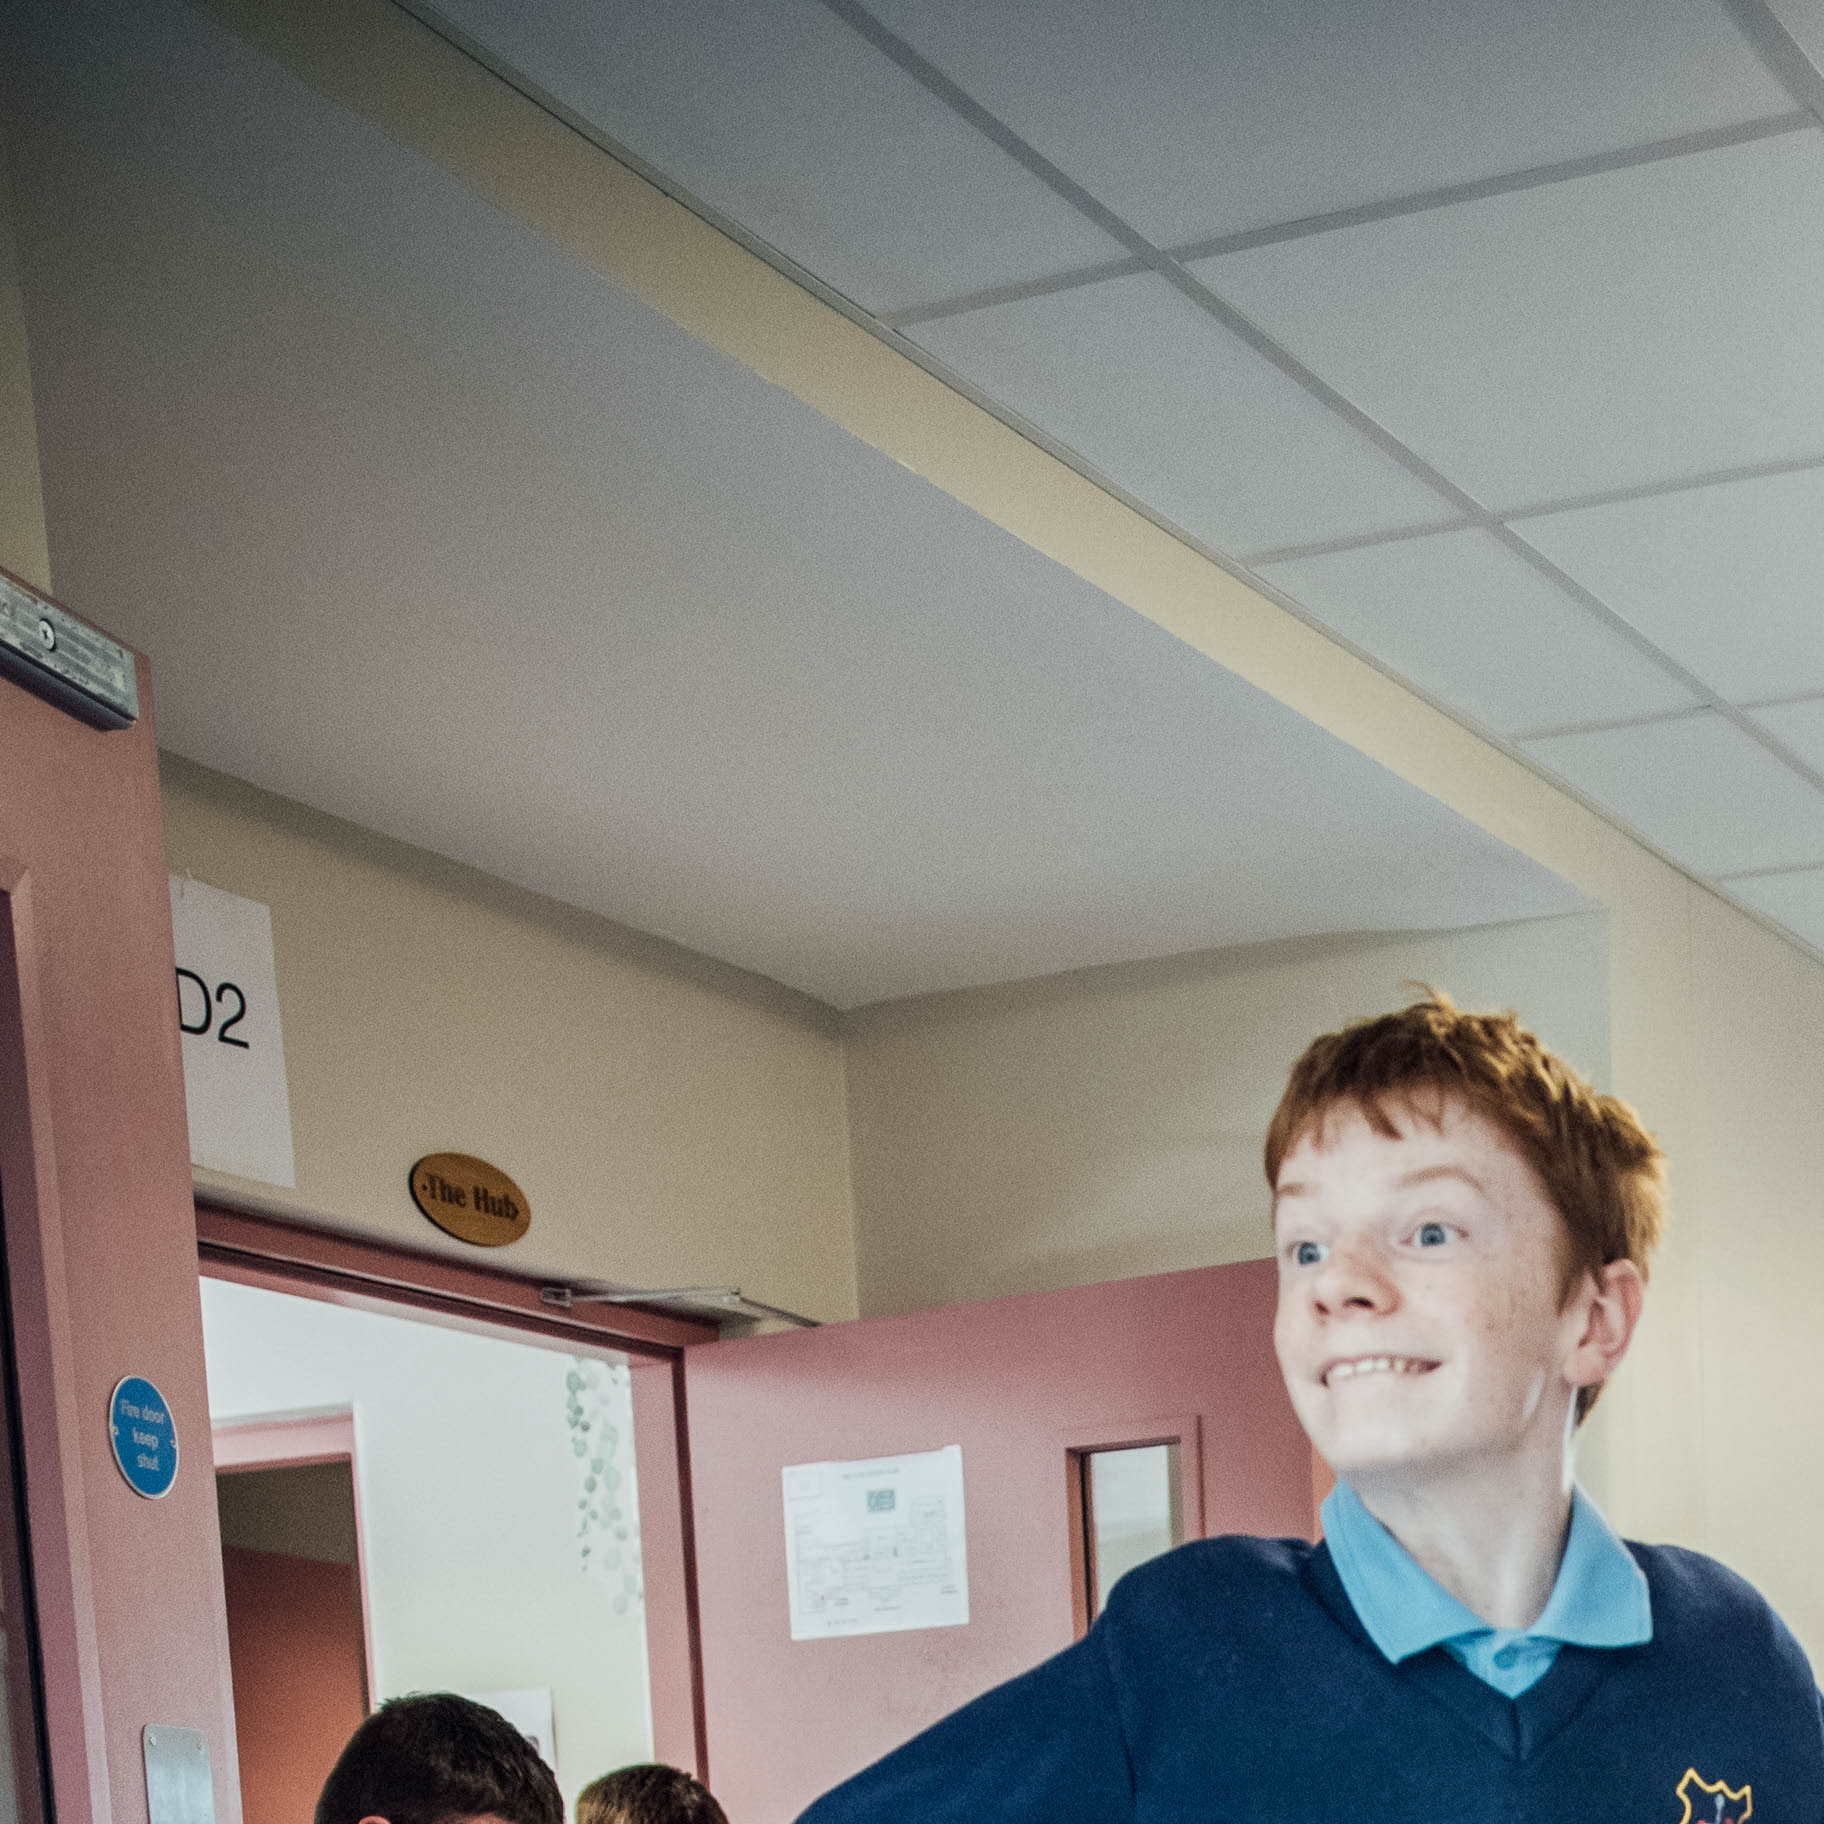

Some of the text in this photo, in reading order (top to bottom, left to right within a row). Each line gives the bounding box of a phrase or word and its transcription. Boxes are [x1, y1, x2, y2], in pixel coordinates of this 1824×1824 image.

[175, 966, 250, 1050] D2
[426, 1172, 517, 1221] The Hub
[119, 1398, 165, 1425] Fire door
[132, 1427, 159, 1451] keep
